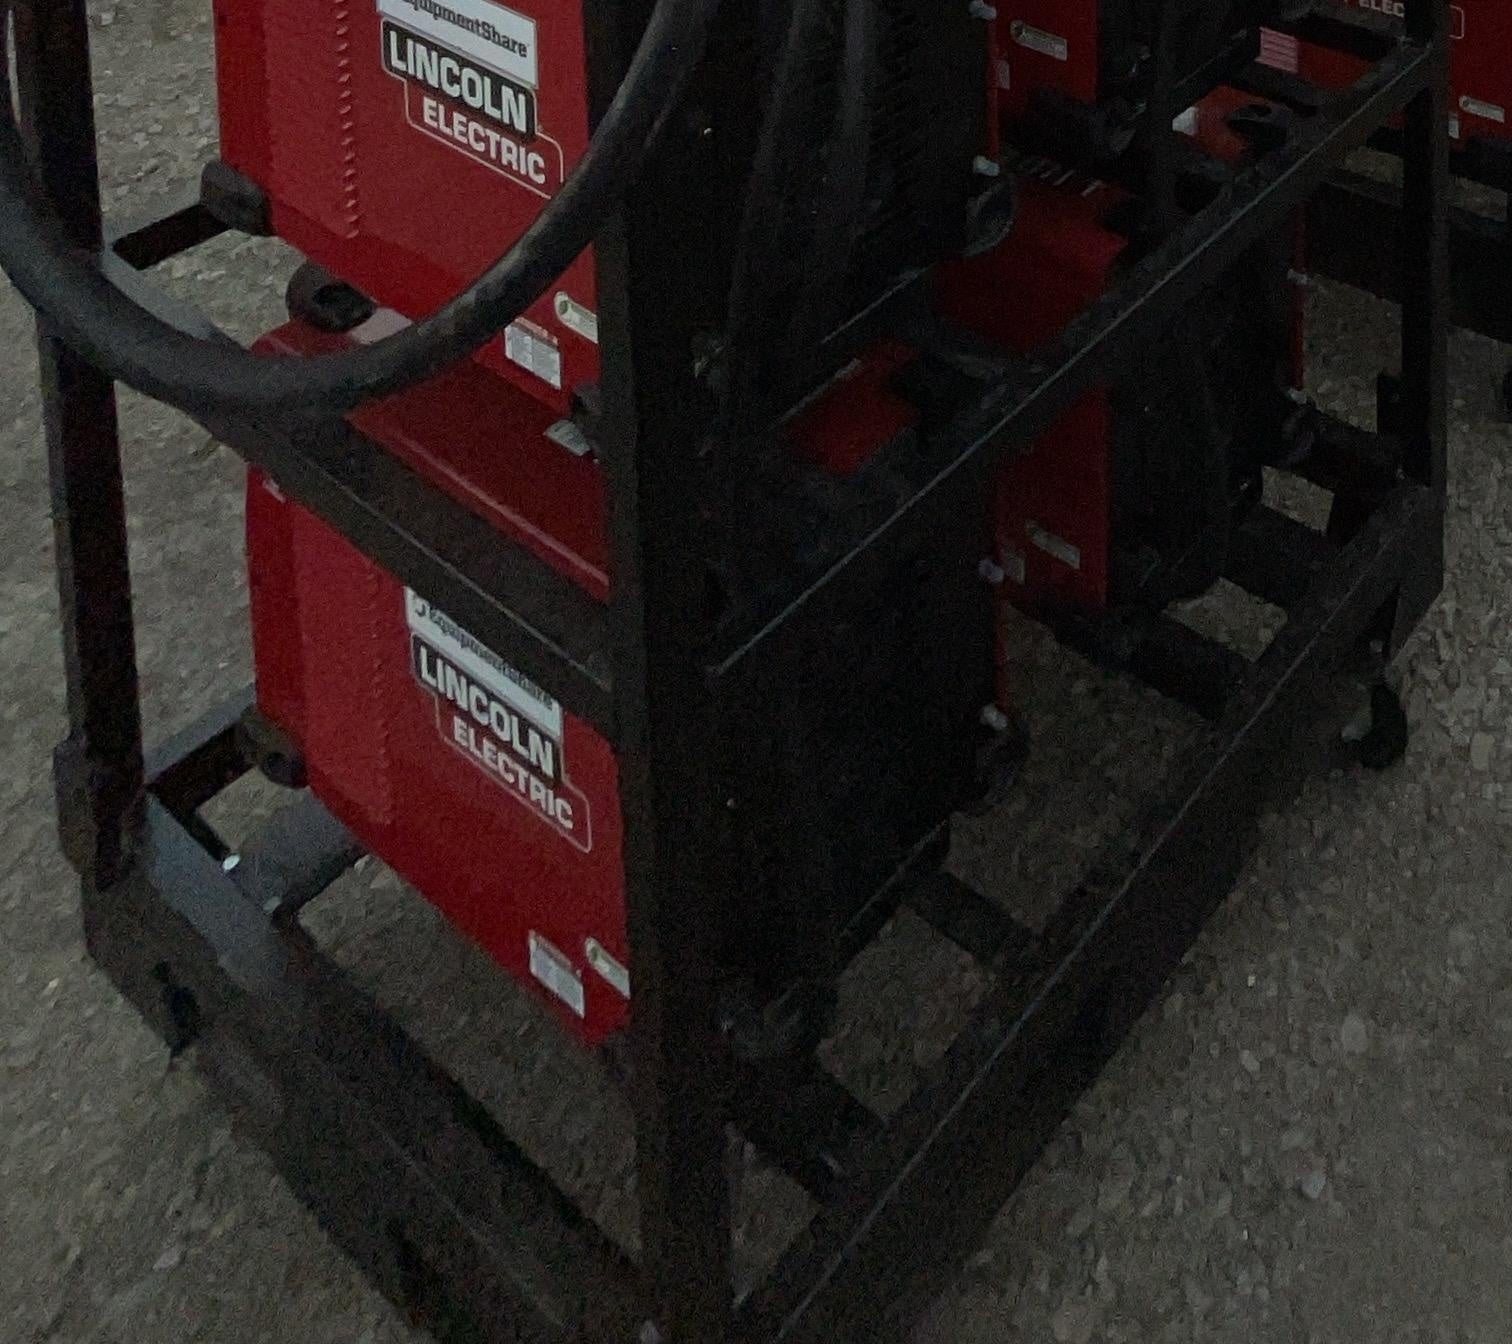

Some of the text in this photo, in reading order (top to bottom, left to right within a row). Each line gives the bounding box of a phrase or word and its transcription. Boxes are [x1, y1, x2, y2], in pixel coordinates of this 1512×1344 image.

[390, 30, 527, 133] LINCOLN
[423, 96, 546, 185] ELECTRIC
[420, 645, 554, 779] LINCOLN
[453, 715, 573, 830] ELECTRIC
